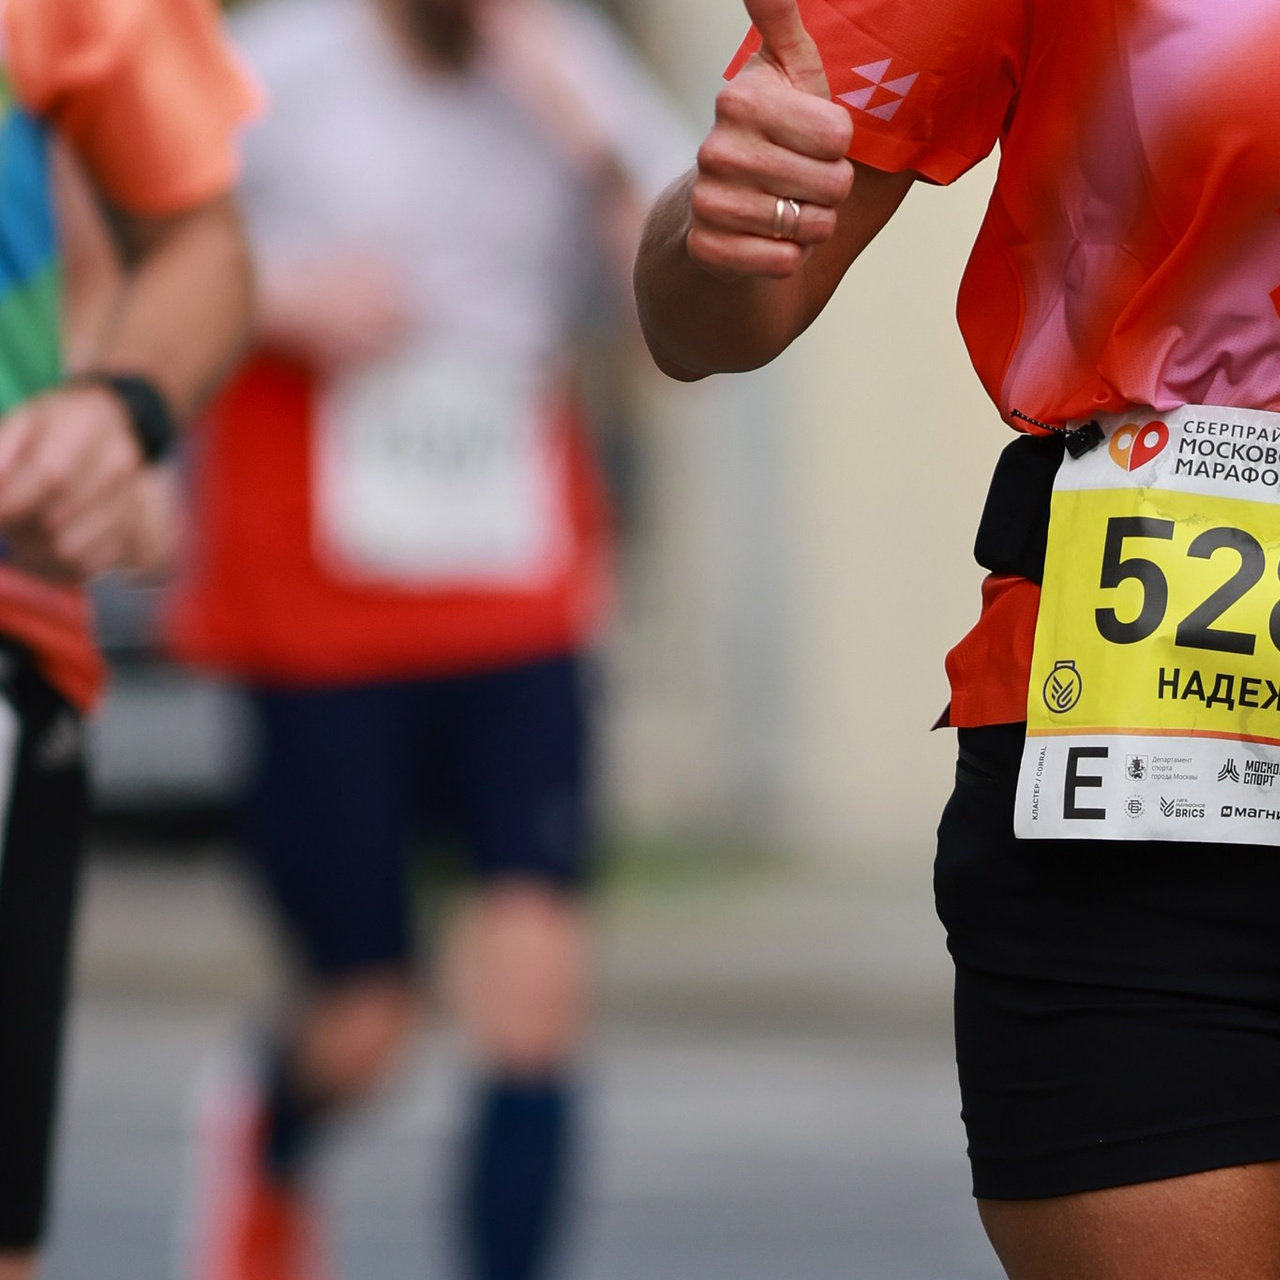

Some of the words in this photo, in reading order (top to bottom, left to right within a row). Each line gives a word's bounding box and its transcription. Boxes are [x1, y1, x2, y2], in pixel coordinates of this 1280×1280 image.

[1036, 746, 1047, 776] CORRAL
[1151, 755, 1193, 765] Департамент
[1151, 764, 1173, 772] спорта
[1151, 773, 1172, 781] города
[1173, 773, 1198, 781] Москвы
[1243, 773, 1275, 787] СПОРТ
[1032, 783, 1041, 820] КЛАСТЕР
[1175, 808, 1206, 818] BRICS
